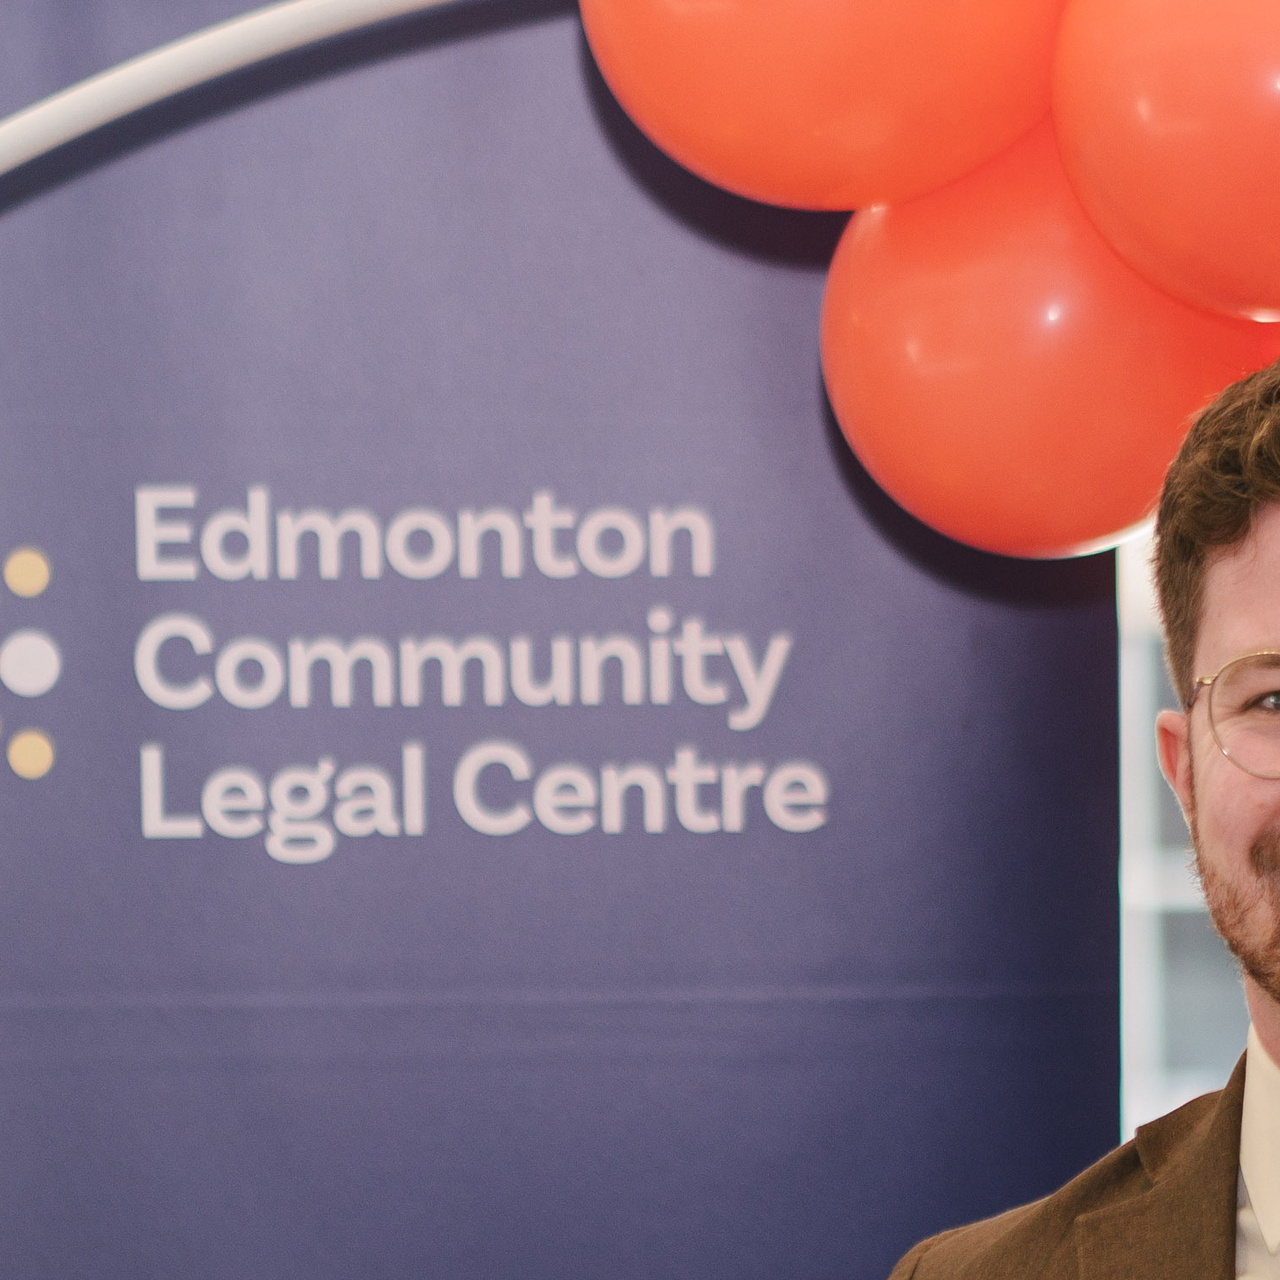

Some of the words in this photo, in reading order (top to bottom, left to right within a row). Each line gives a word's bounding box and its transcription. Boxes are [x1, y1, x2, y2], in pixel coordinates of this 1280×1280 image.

[135, 485, 714, 582] Edmonton
[134, 606, 794, 731] Community
[140, 742, 426, 865] Legal
[453, 741, 829, 835] Centre
